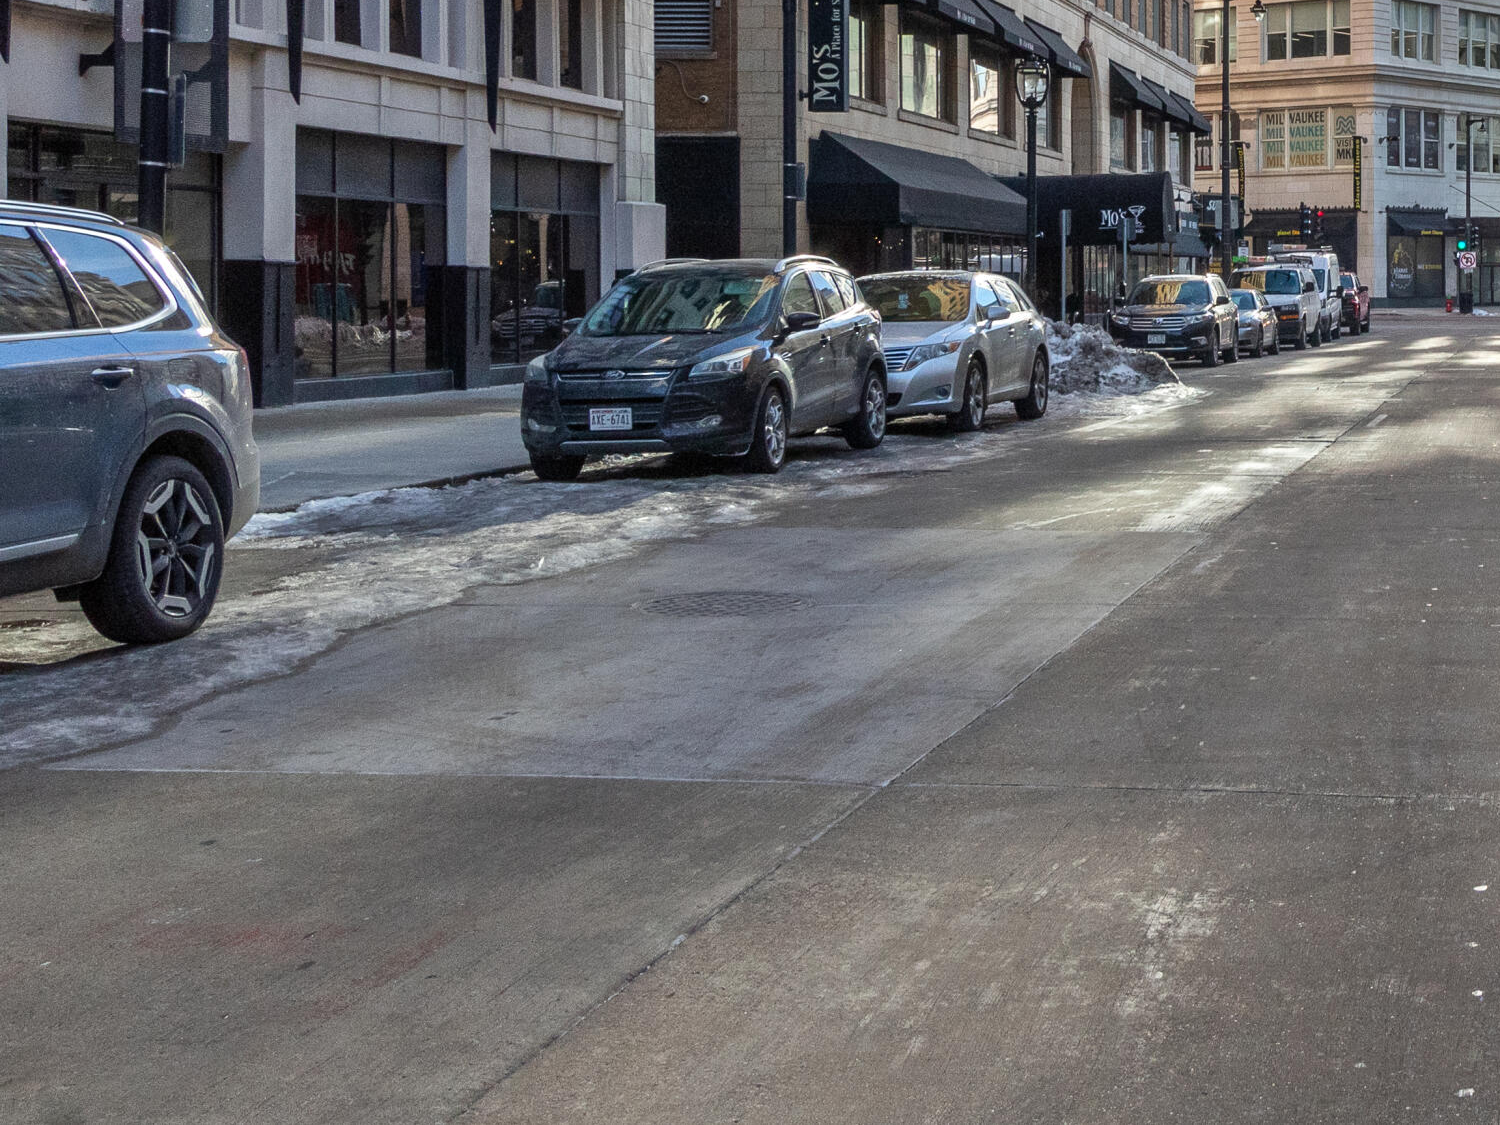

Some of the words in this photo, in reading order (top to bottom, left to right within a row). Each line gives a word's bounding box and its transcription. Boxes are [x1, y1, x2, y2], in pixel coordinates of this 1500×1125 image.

[831, 9, 841, 21] for
[830, 25, 841, 50] Place
[1336, 139, 1352, 147] VISI
[591, 414, 630, 426] AXE-6741
